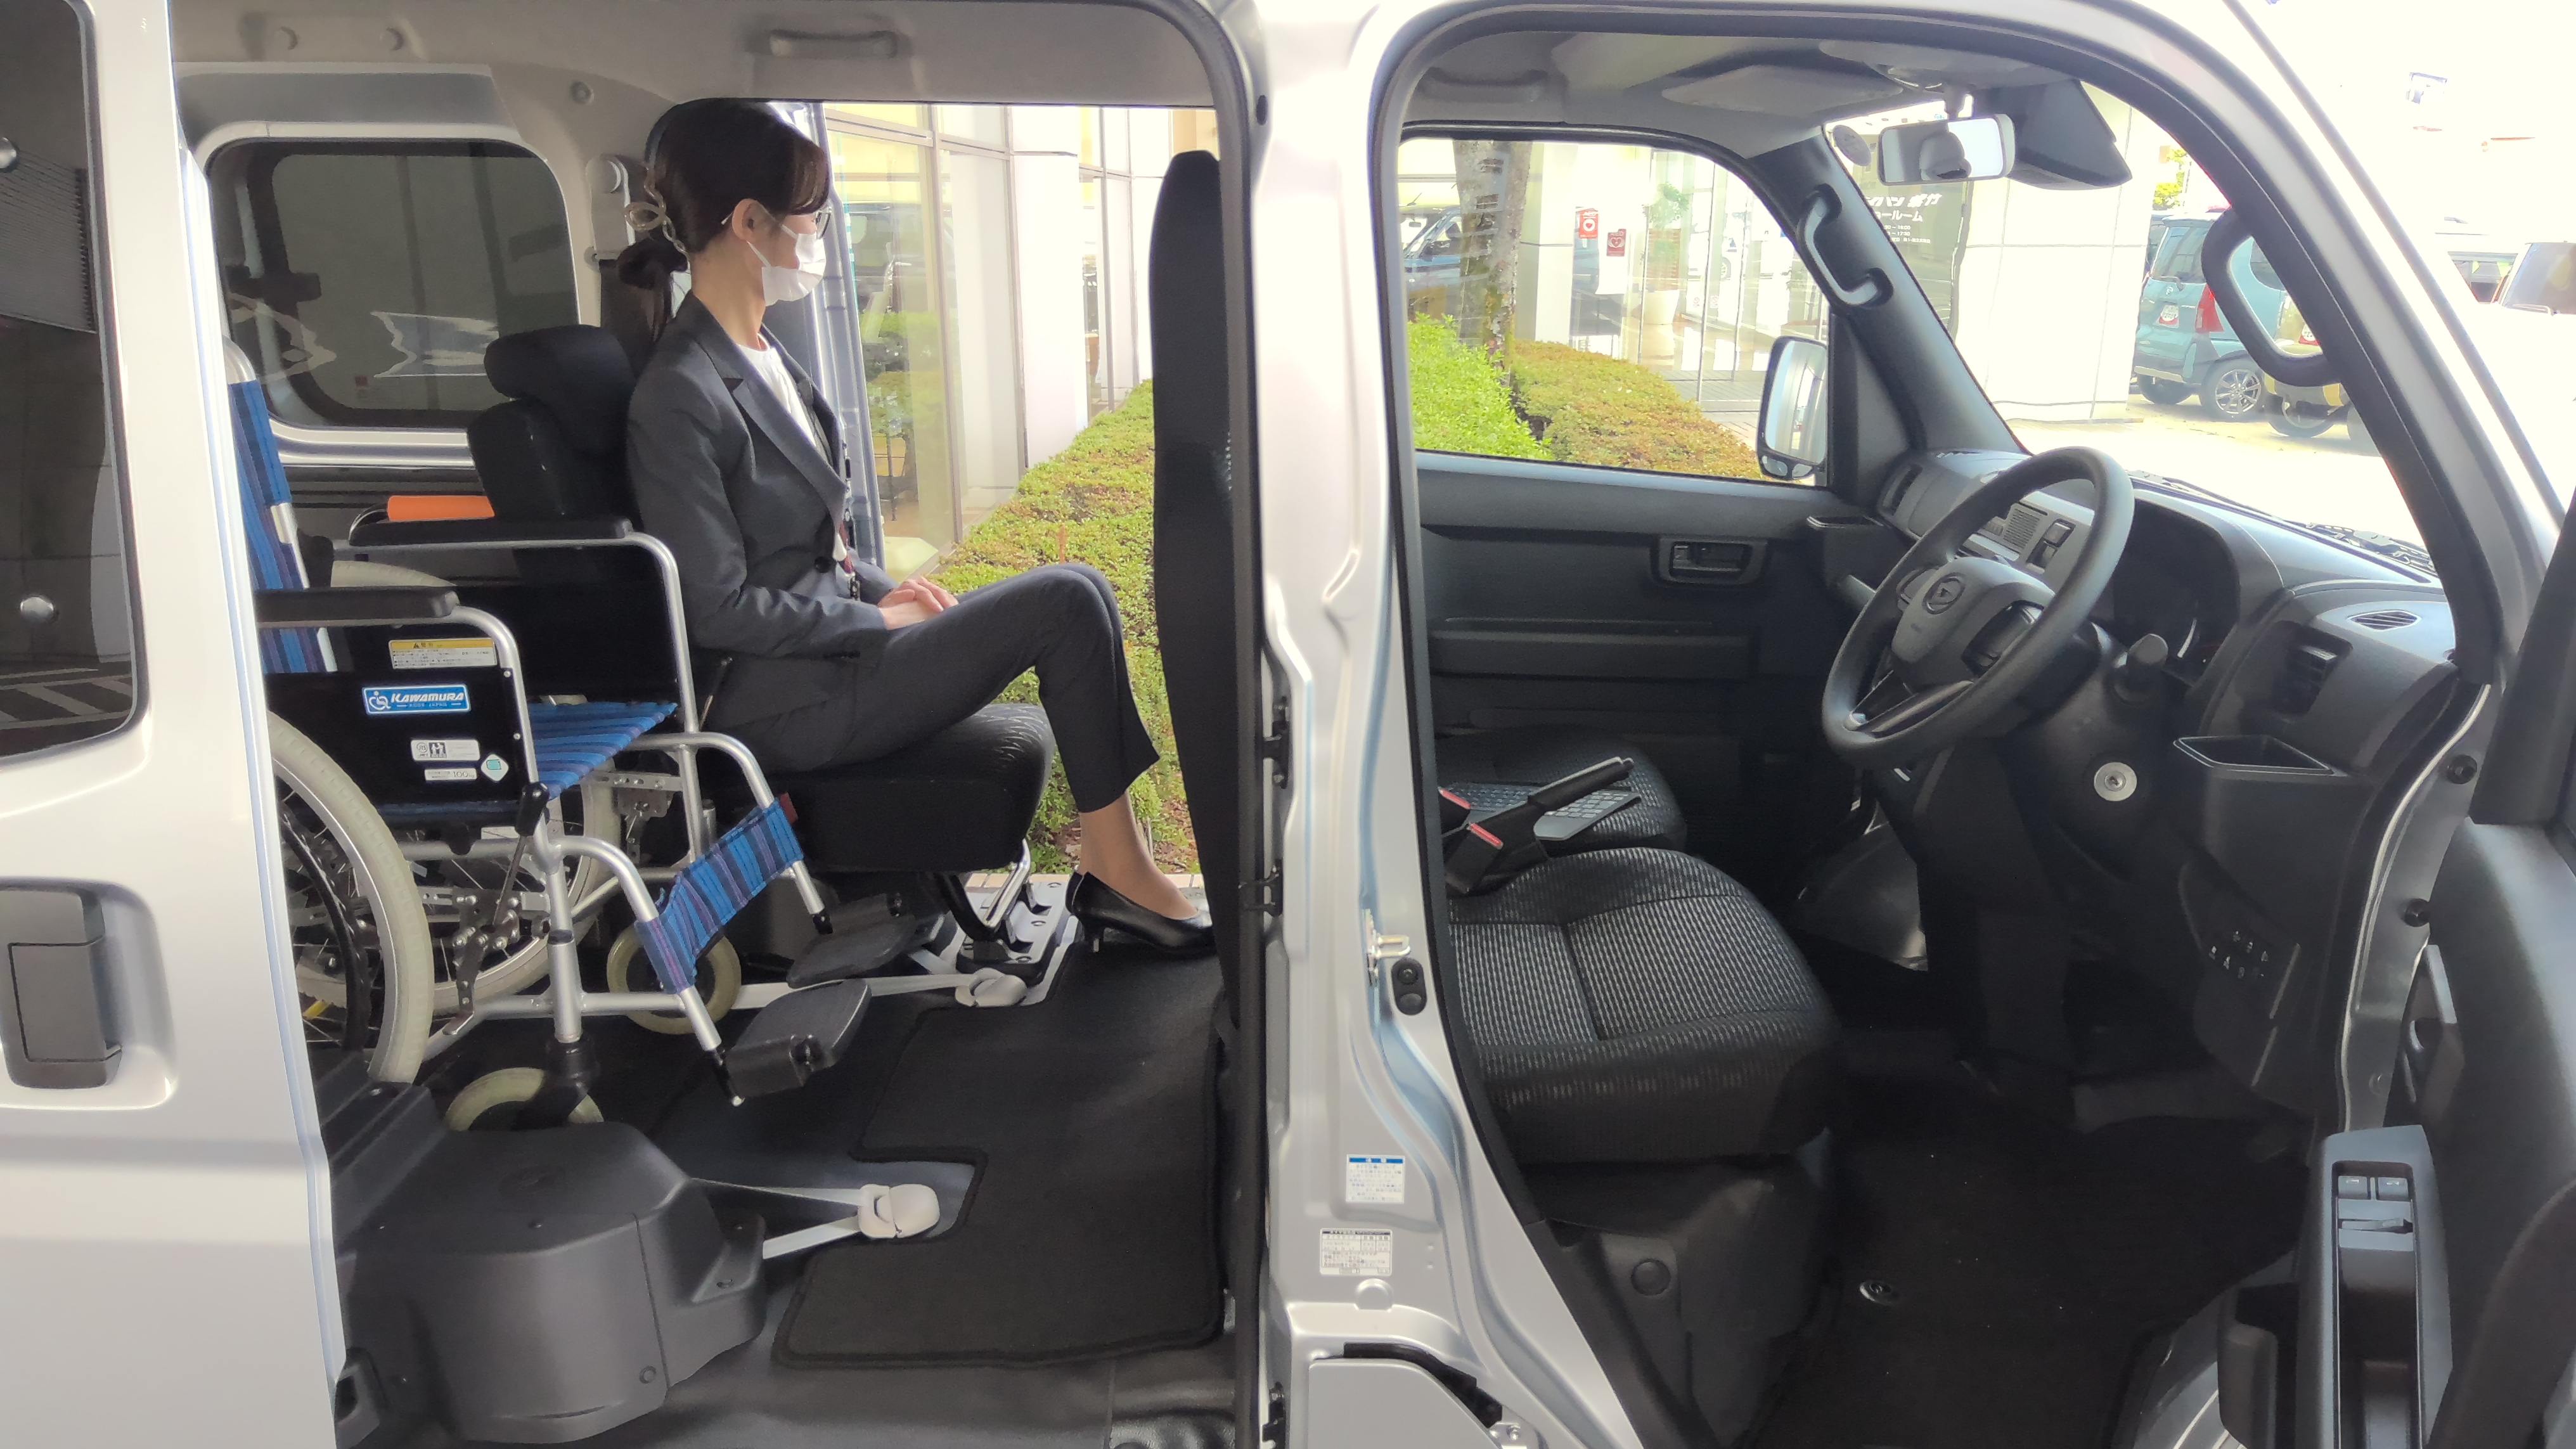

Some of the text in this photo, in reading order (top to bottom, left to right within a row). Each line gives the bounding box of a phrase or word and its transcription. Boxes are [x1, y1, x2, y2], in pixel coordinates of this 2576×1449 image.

[1866, 196, 1905, 207] イハツ
[1874, 209, 1923, 222] ョールーム
[390, 692, 465, 704] KAWAMURA
